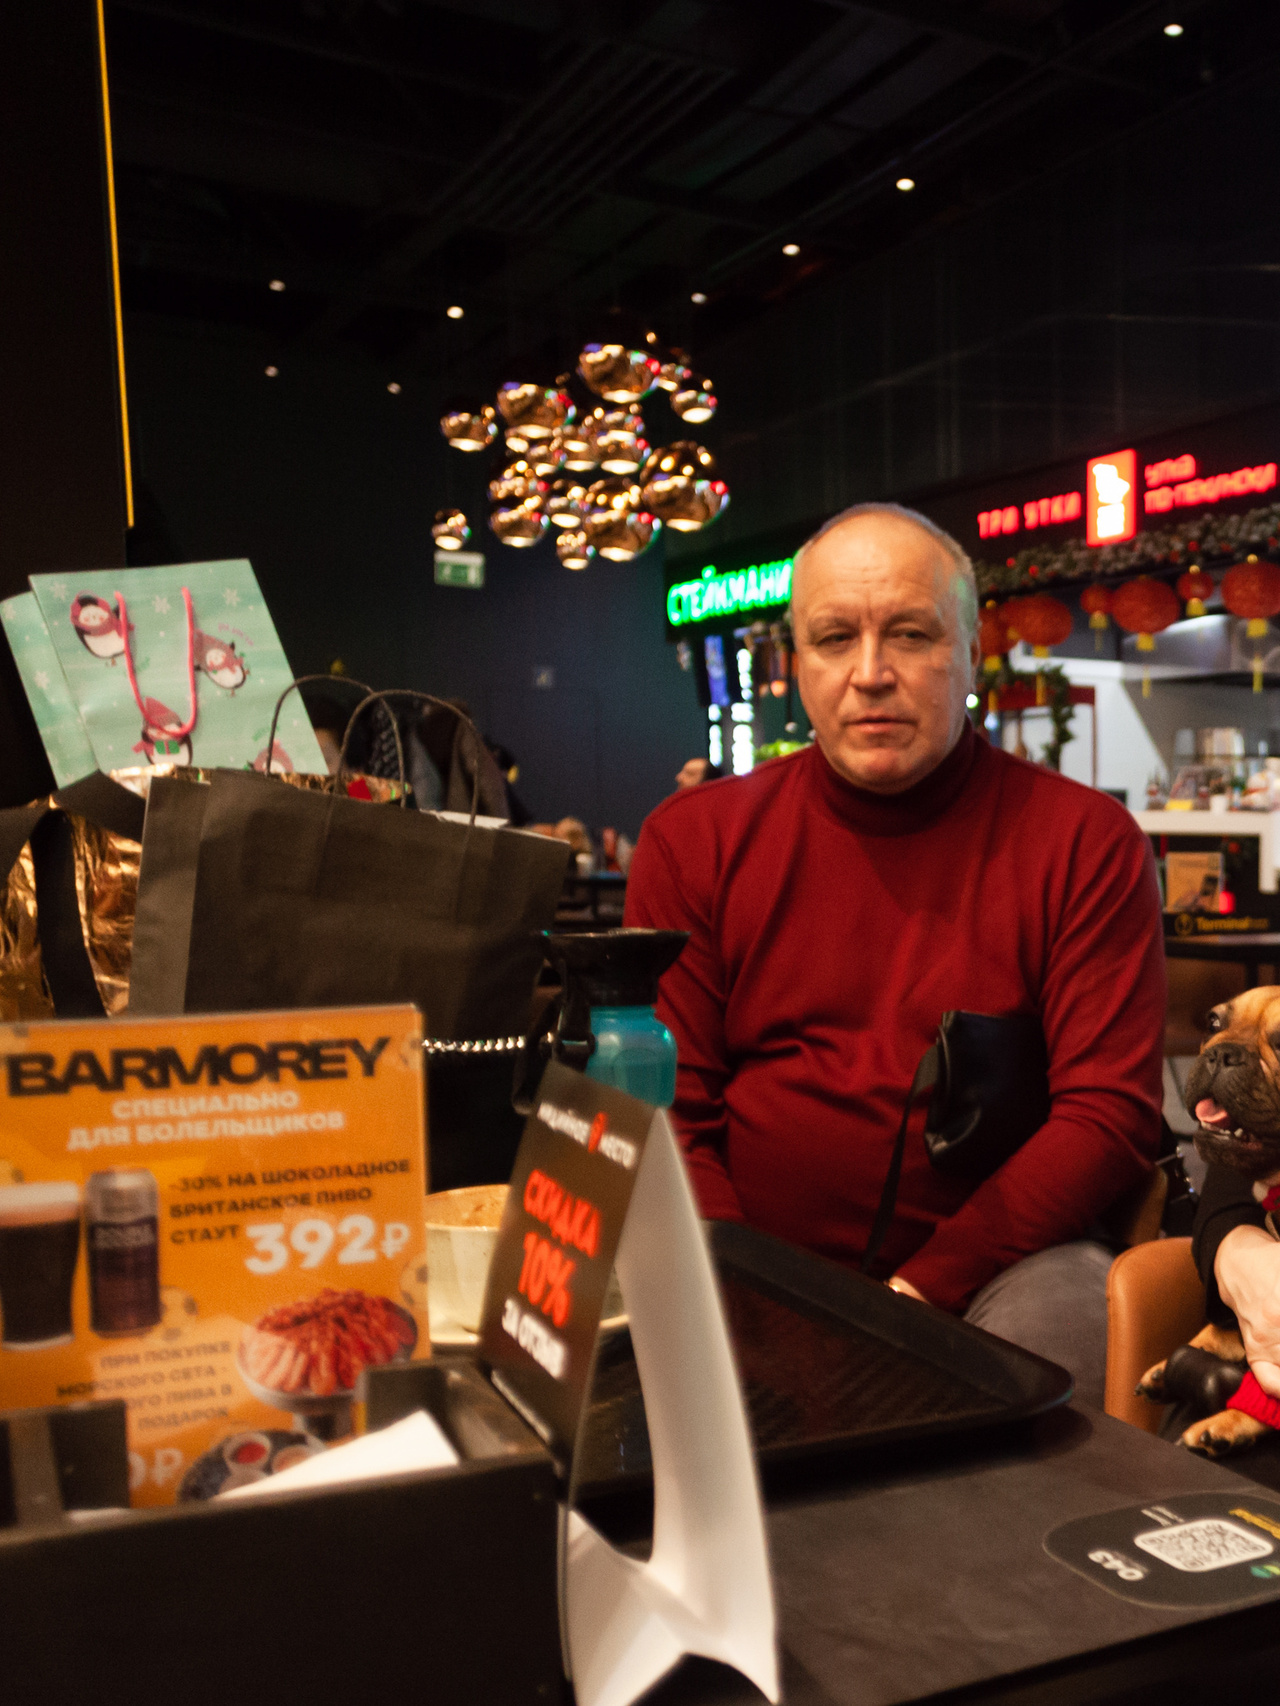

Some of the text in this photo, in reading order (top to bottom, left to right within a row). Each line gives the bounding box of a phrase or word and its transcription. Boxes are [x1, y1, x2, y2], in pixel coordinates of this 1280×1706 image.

[667, 558, 793, 626] СТЕЙКМАНИ
[5, 1036, 391, 1096] BARMOREY
[112, 1090, 299, 1120] СПЕЦИАЛЬНО
[67, 1111, 345, 1151] ДЛЯ БОЛЕЛЬЩИКОВ
[227, 1172, 257, 1188] НА
[261, 1159, 410, 1185] ШОКОЛАДНОЕ
[170, 1187, 372, 1218] БРИТАНСКОЕ ПИВО
[170, 1224, 240, 1245] СТАУТ
[518, 1231, 576, 1328] 10%
